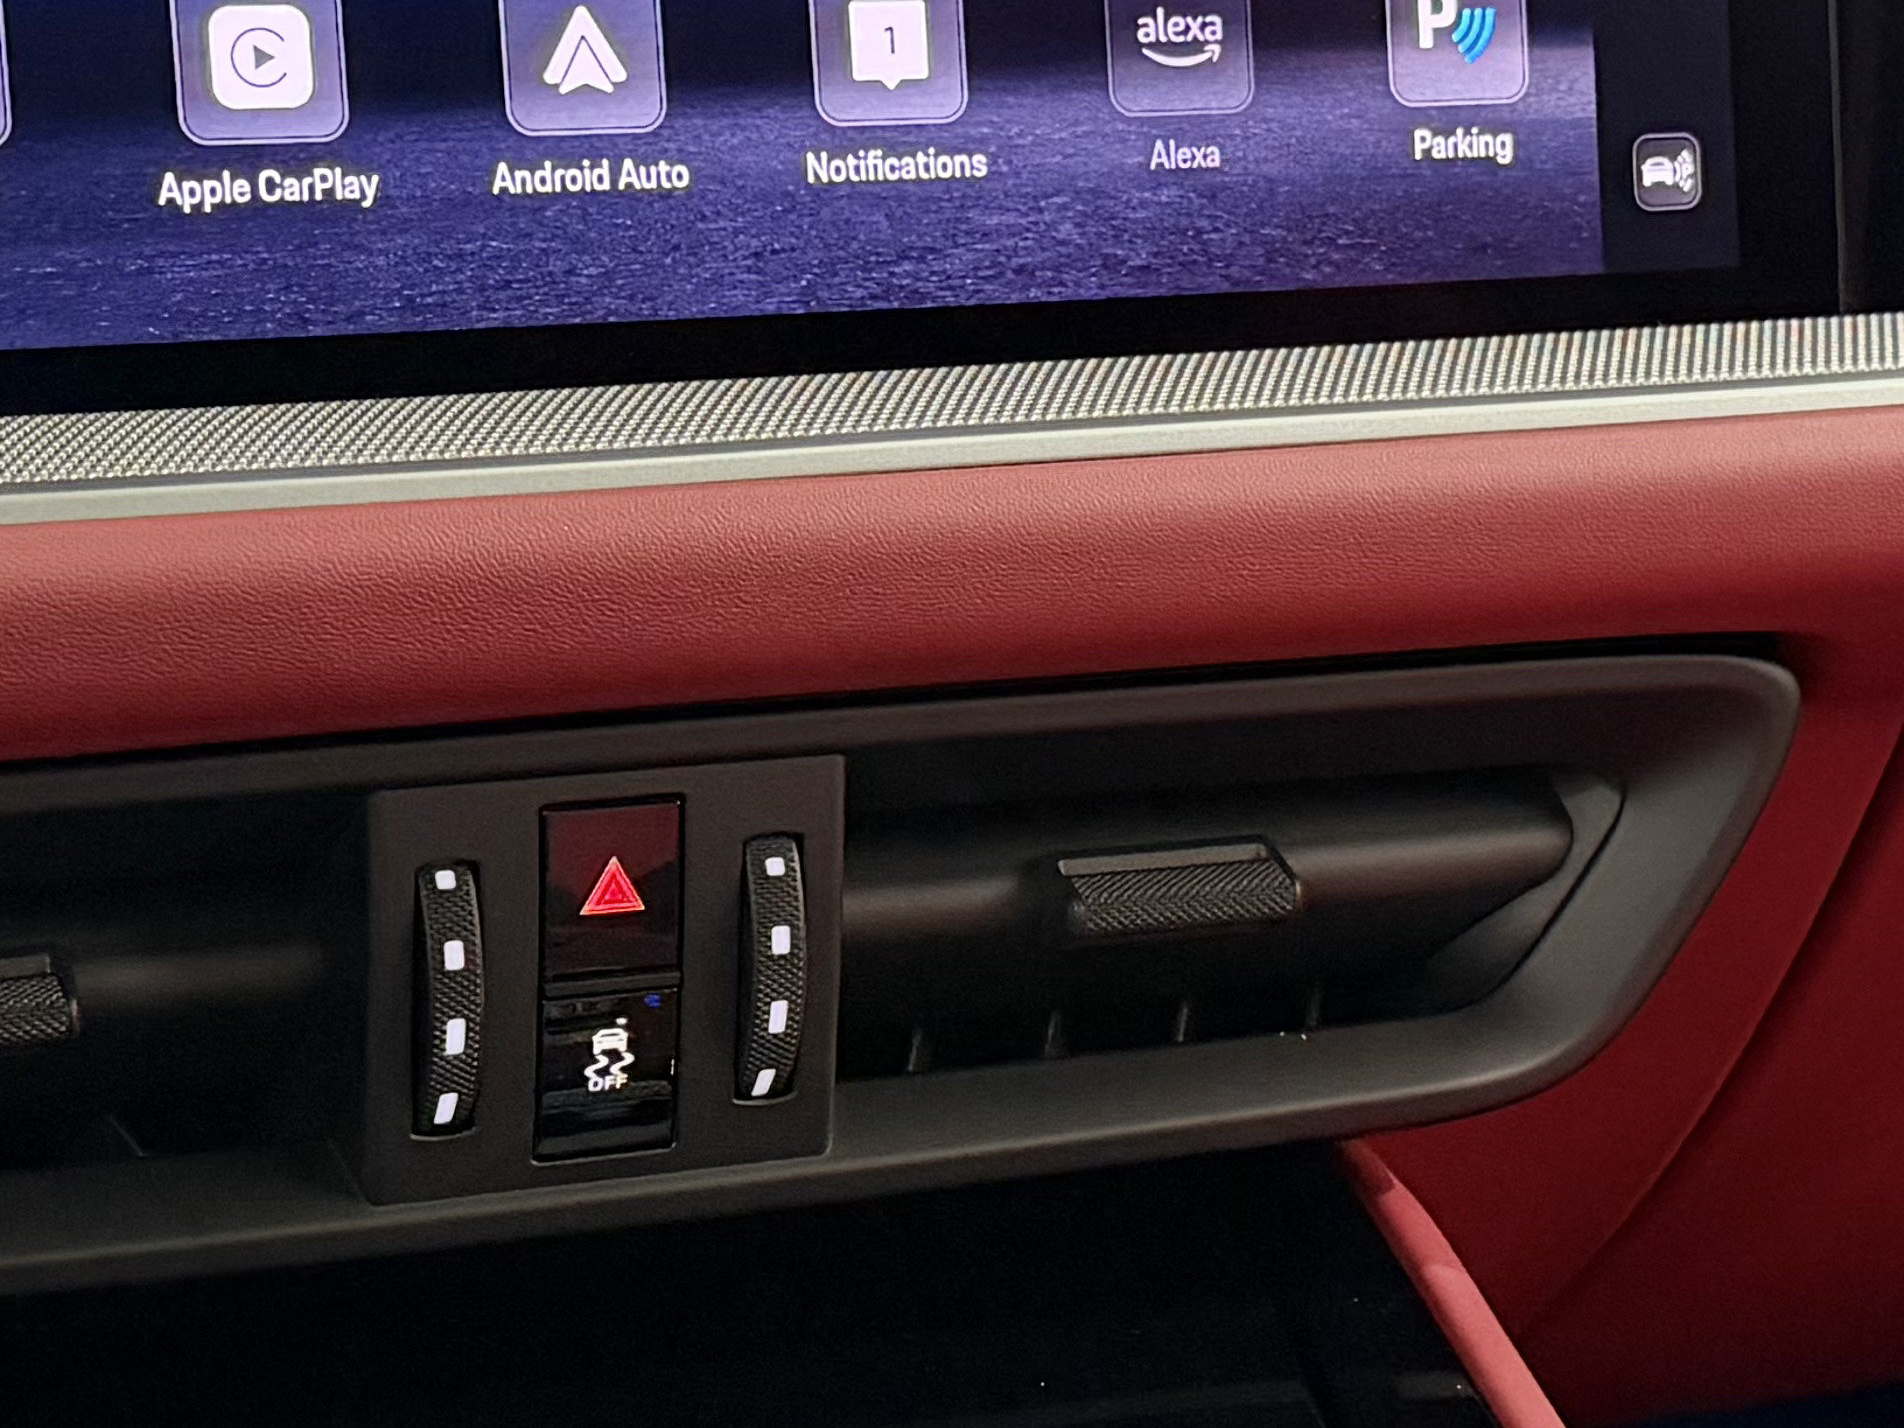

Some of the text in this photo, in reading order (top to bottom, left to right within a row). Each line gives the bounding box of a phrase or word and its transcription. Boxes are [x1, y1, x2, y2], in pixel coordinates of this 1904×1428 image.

[1135, 7, 1224, 44] alexa
[806, 145, 988, 184] Notifications
[1149, 138, 1222, 171] Alexa
[1413, 126, 1514, 165] Parking
[158, 166, 381, 214] Apple CarPlay
[492, 158, 690, 196] Android Auto
[587, 1074, 629, 1092] OFF
